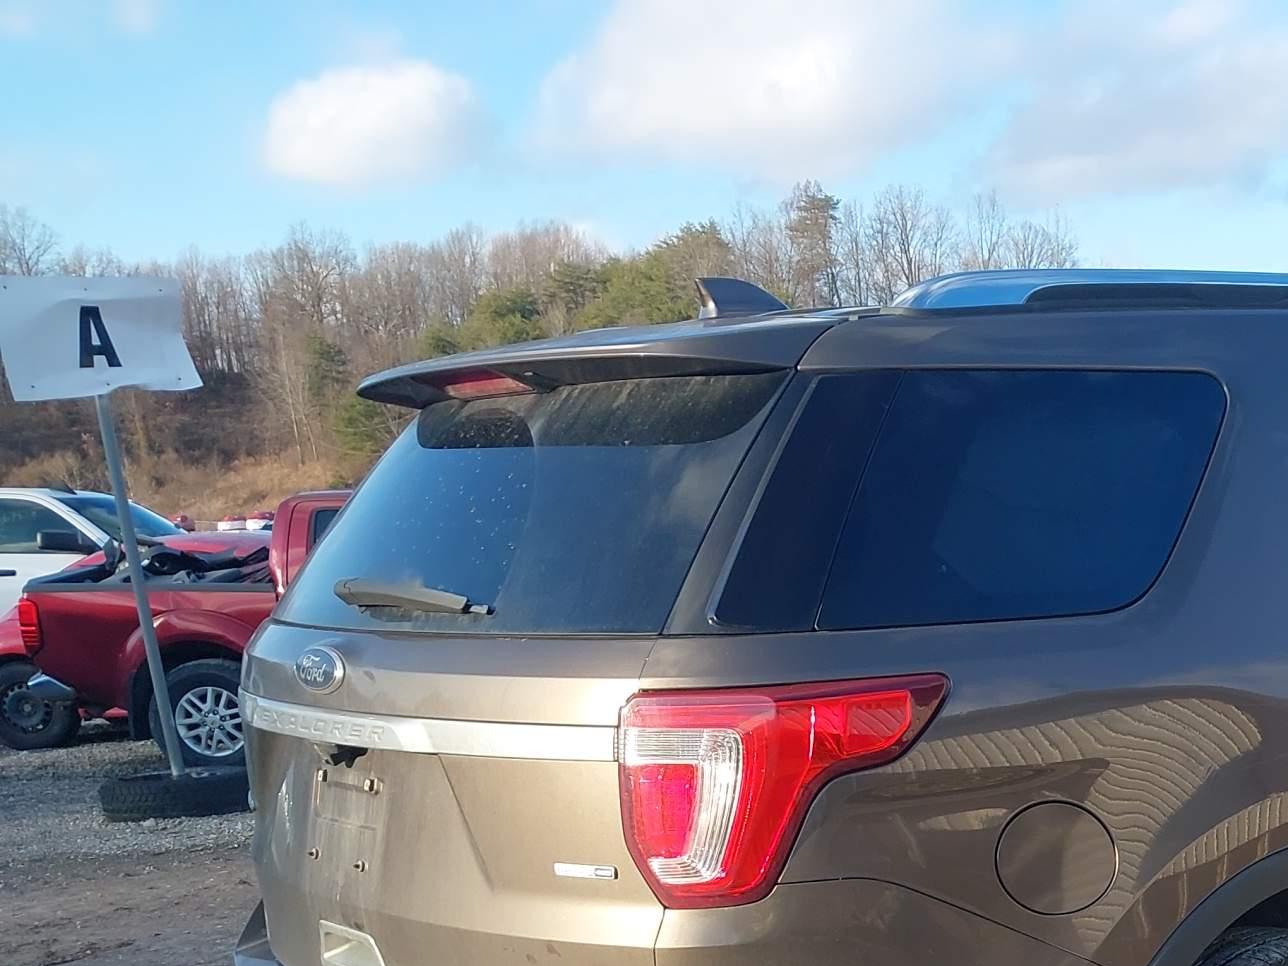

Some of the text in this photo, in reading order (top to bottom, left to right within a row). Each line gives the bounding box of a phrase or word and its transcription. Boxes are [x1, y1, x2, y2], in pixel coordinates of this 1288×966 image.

[80, 306, 122, 368] A
[300, 654, 326, 682] Ford
[261, 711, 386, 742] EXPLORER
